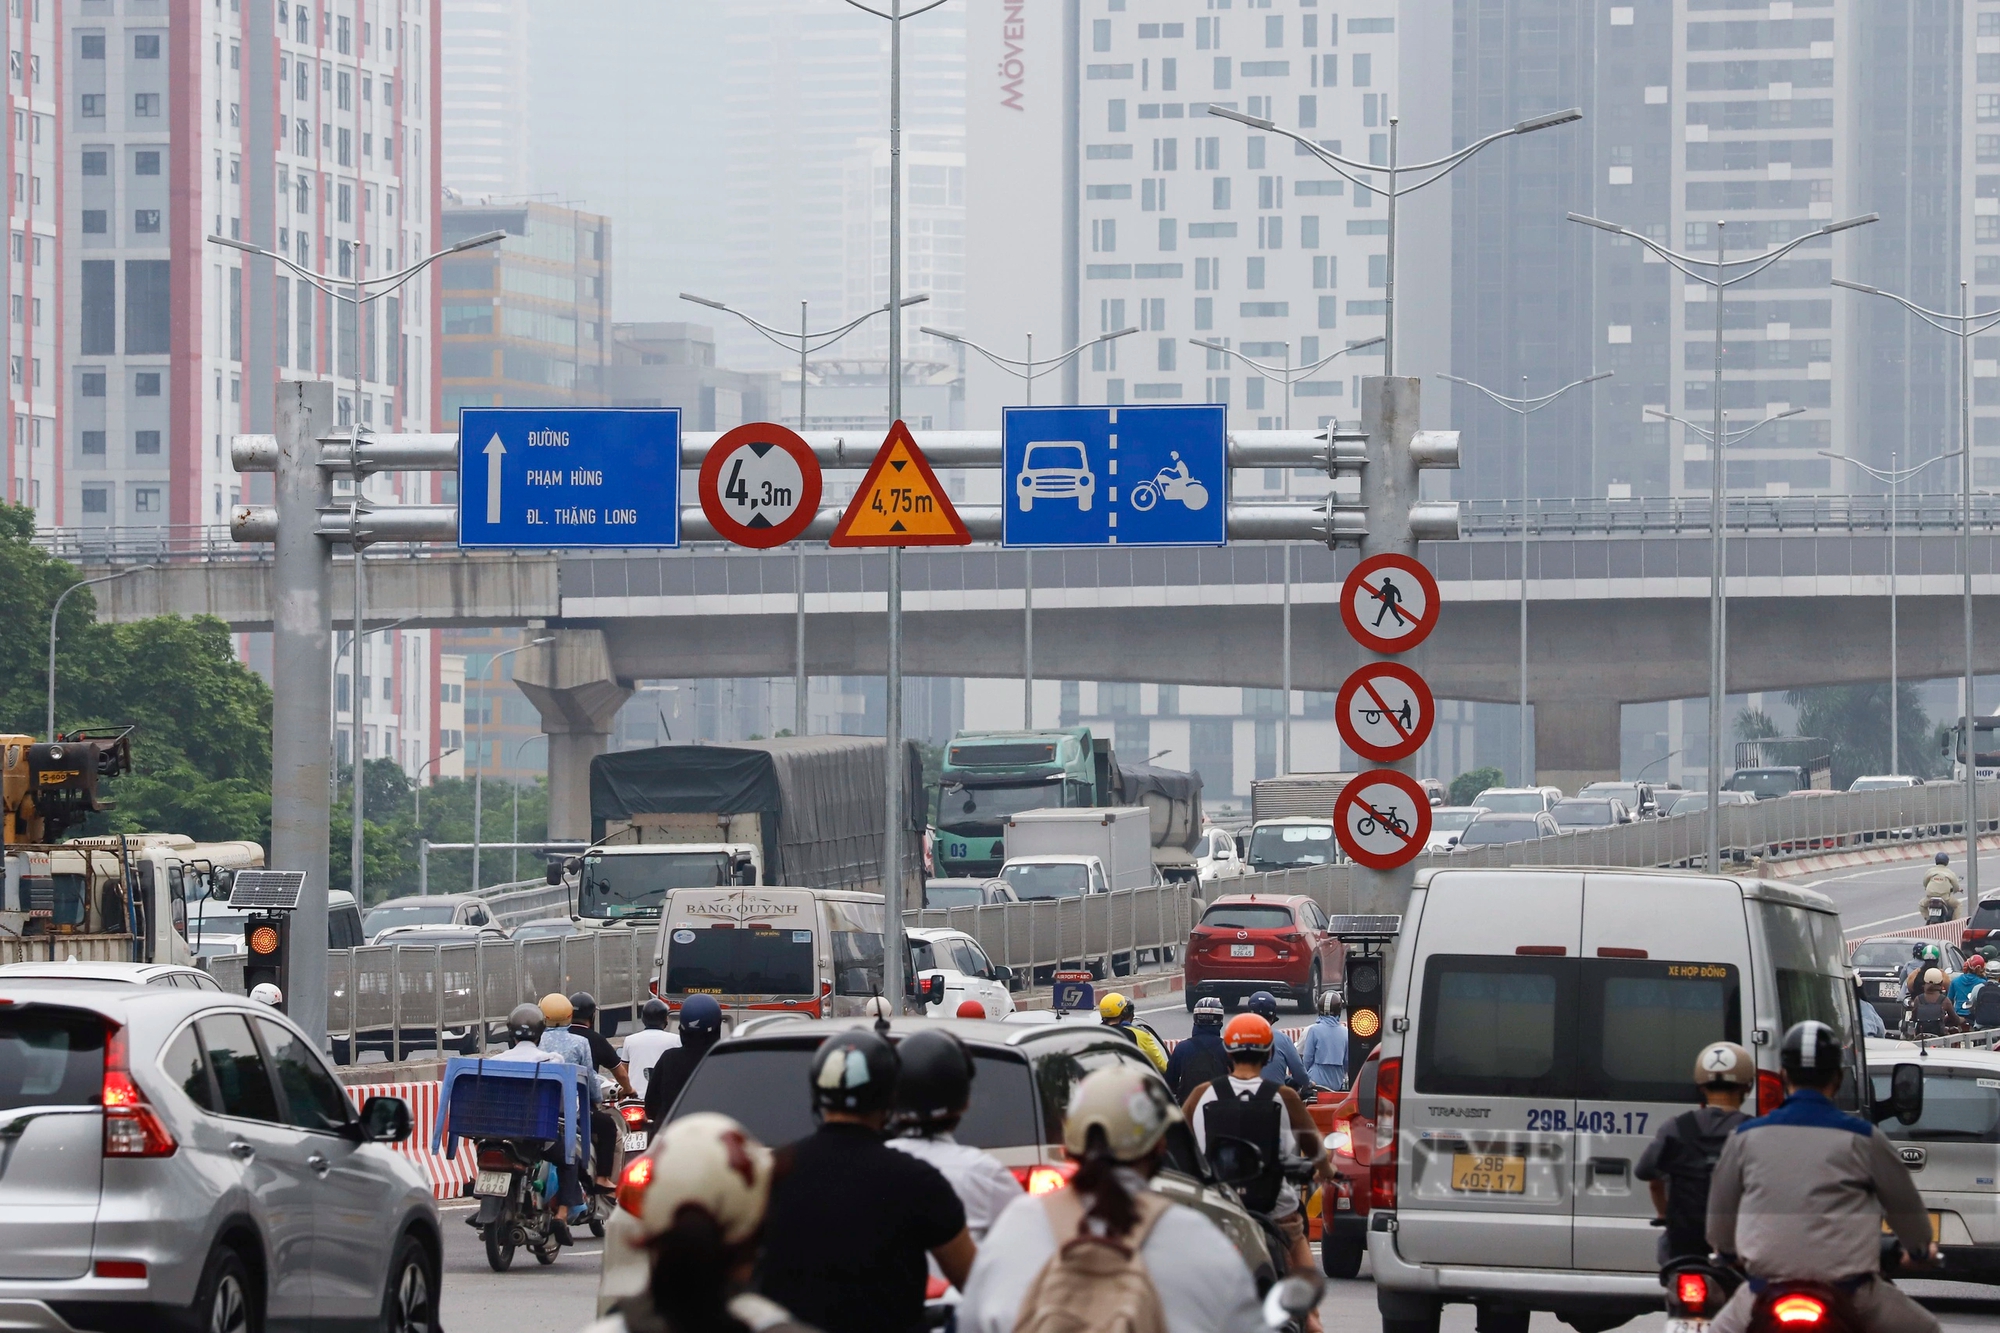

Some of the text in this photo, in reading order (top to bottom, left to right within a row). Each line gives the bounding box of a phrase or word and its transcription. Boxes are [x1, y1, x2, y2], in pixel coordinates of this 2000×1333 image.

[998, 0, 1025, 111] MÖVEN
[528, 426, 570, 447] ĐƯỜNG
[526, 466, 603, 489] PHẠM HÙNG
[725, 458, 792, 511] 4,3m
[526, 508, 549, 525] ĐL.
[604, 508, 637, 525] LONG
[950, 843, 967, 858] 03
[1668, 966, 1679, 976] XE
[1681, 966, 1699, 979] HỢP
[1062, 986, 1084, 1007] G7
[1428, 1106, 1491, 1119] TRANSIT
[1903, 1151, 1920, 1159] KIA
[1473, 1157, 1504, 1171] 29B
[1459, 1173, 1517, 1189] 403.17
